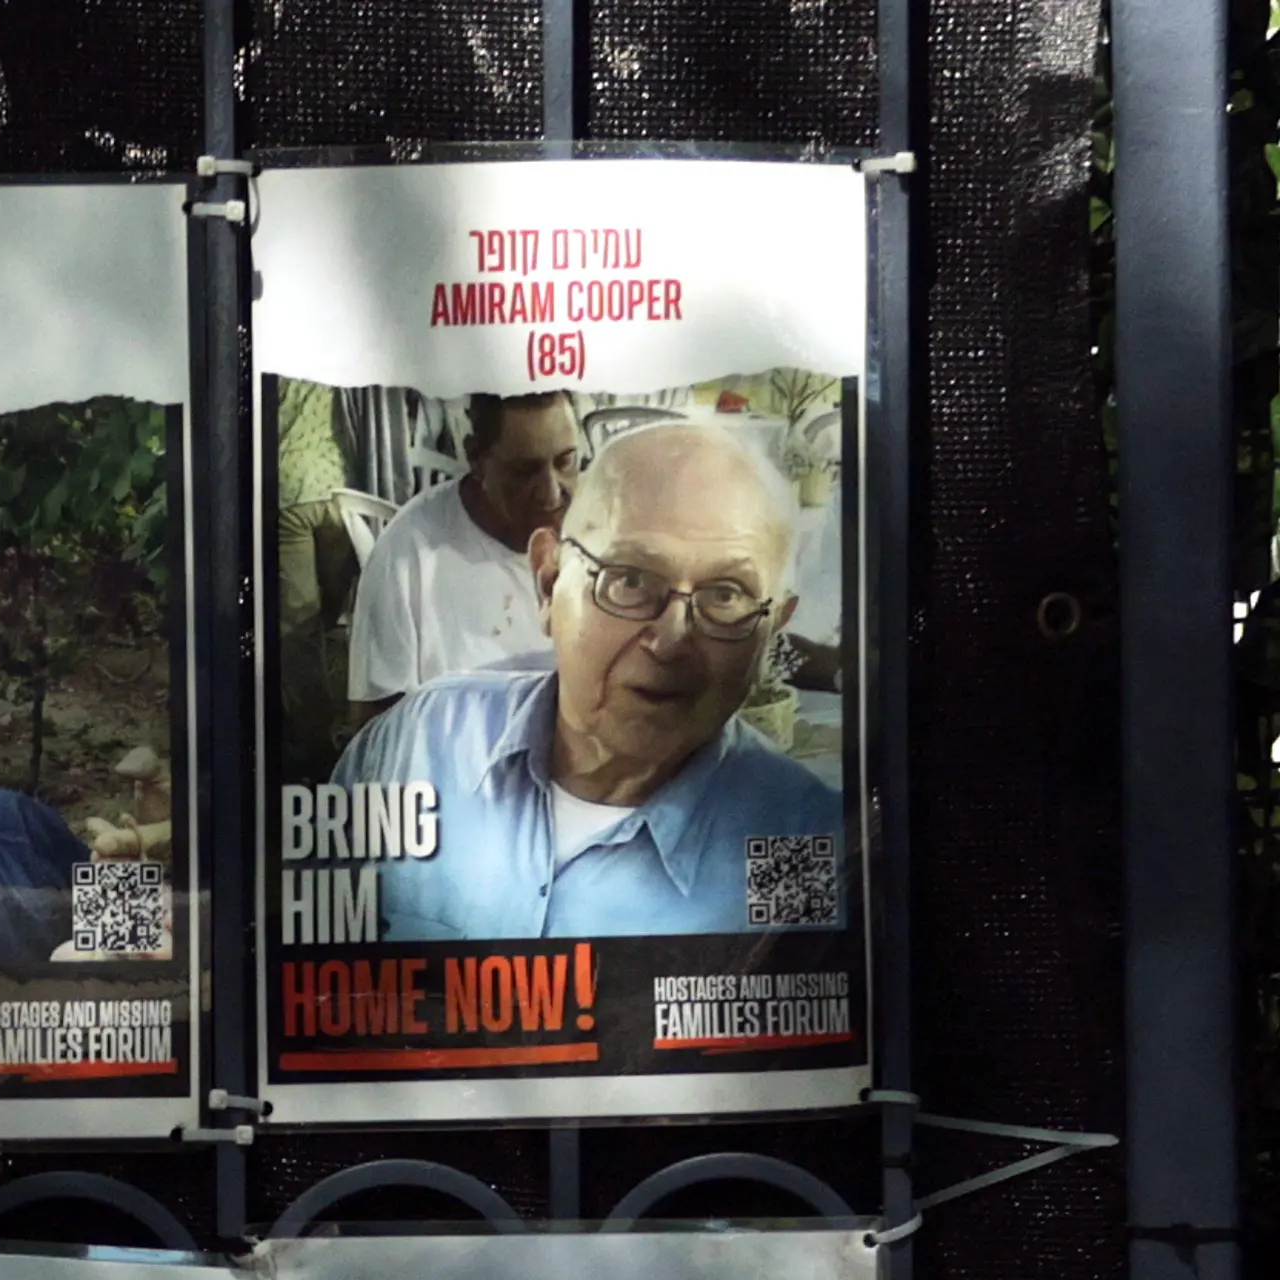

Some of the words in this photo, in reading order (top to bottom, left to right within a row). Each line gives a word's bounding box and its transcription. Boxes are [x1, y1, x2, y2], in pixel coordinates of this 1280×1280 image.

[470, 230, 539, 275] קופר
[554, 229, 642, 270] עמירם
[431, 282, 554, 326] AMIRAM
[568, 279, 682, 322] COOPER
[527, 332, 584, 379] (85)
[281, 780, 438, 860] BRING
[282, 868, 378, 945] HIM
[282, 959, 428, 1038] HOME
[445, 943, 595, 1033] NOW!
[62, 1002, 96, 1027] AND
[99, 1002, 171, 1027] MISSING
[89, 1028, 171, 1063] FORUM
